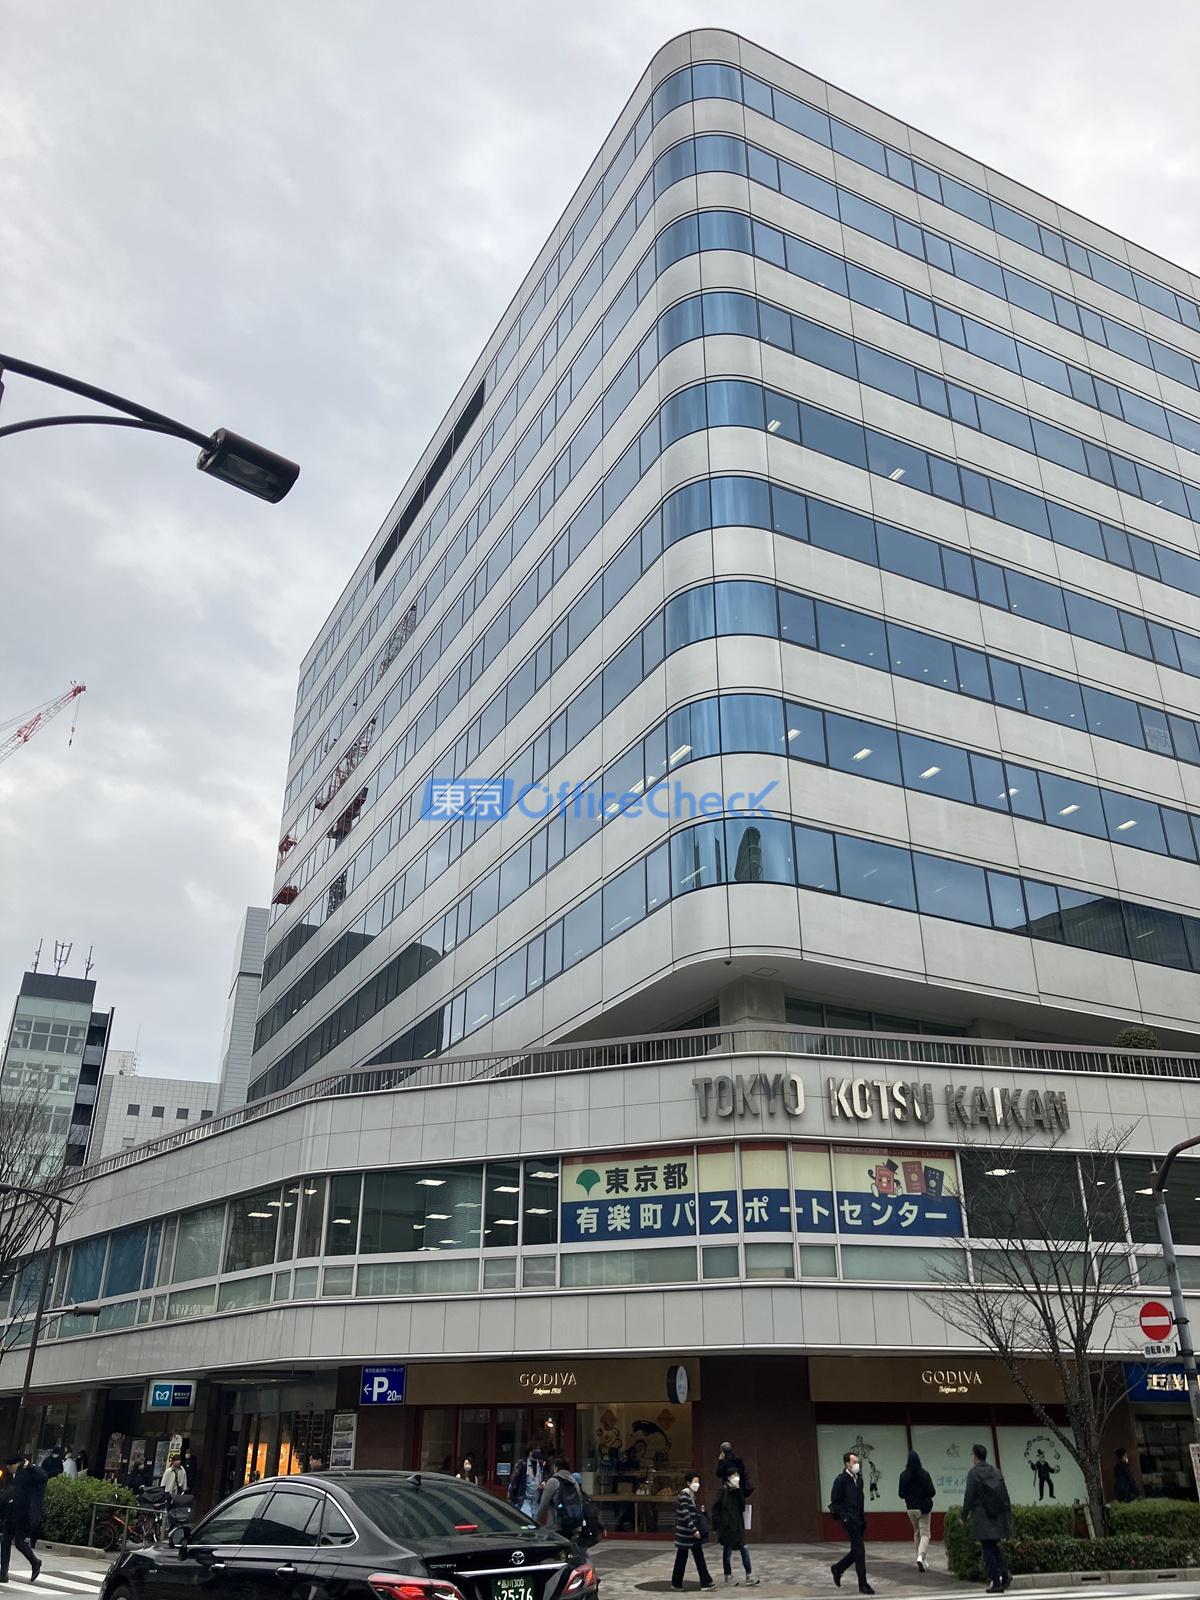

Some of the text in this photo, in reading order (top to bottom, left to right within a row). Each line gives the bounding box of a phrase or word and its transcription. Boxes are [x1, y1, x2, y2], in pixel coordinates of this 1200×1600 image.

[692, 1073, 1071, 1130] TOKYO KOTSU KAIKAN
[604, 1162, 690, 1194] 東京都
[575, 1196, 948, 1234] 有楽町パスポートセンター
[372, 1376, 402, 1402] P 20m
[519, 1372, 577, 1387] GODIVA
[921, 1370, 983, 1384] GODIVA
